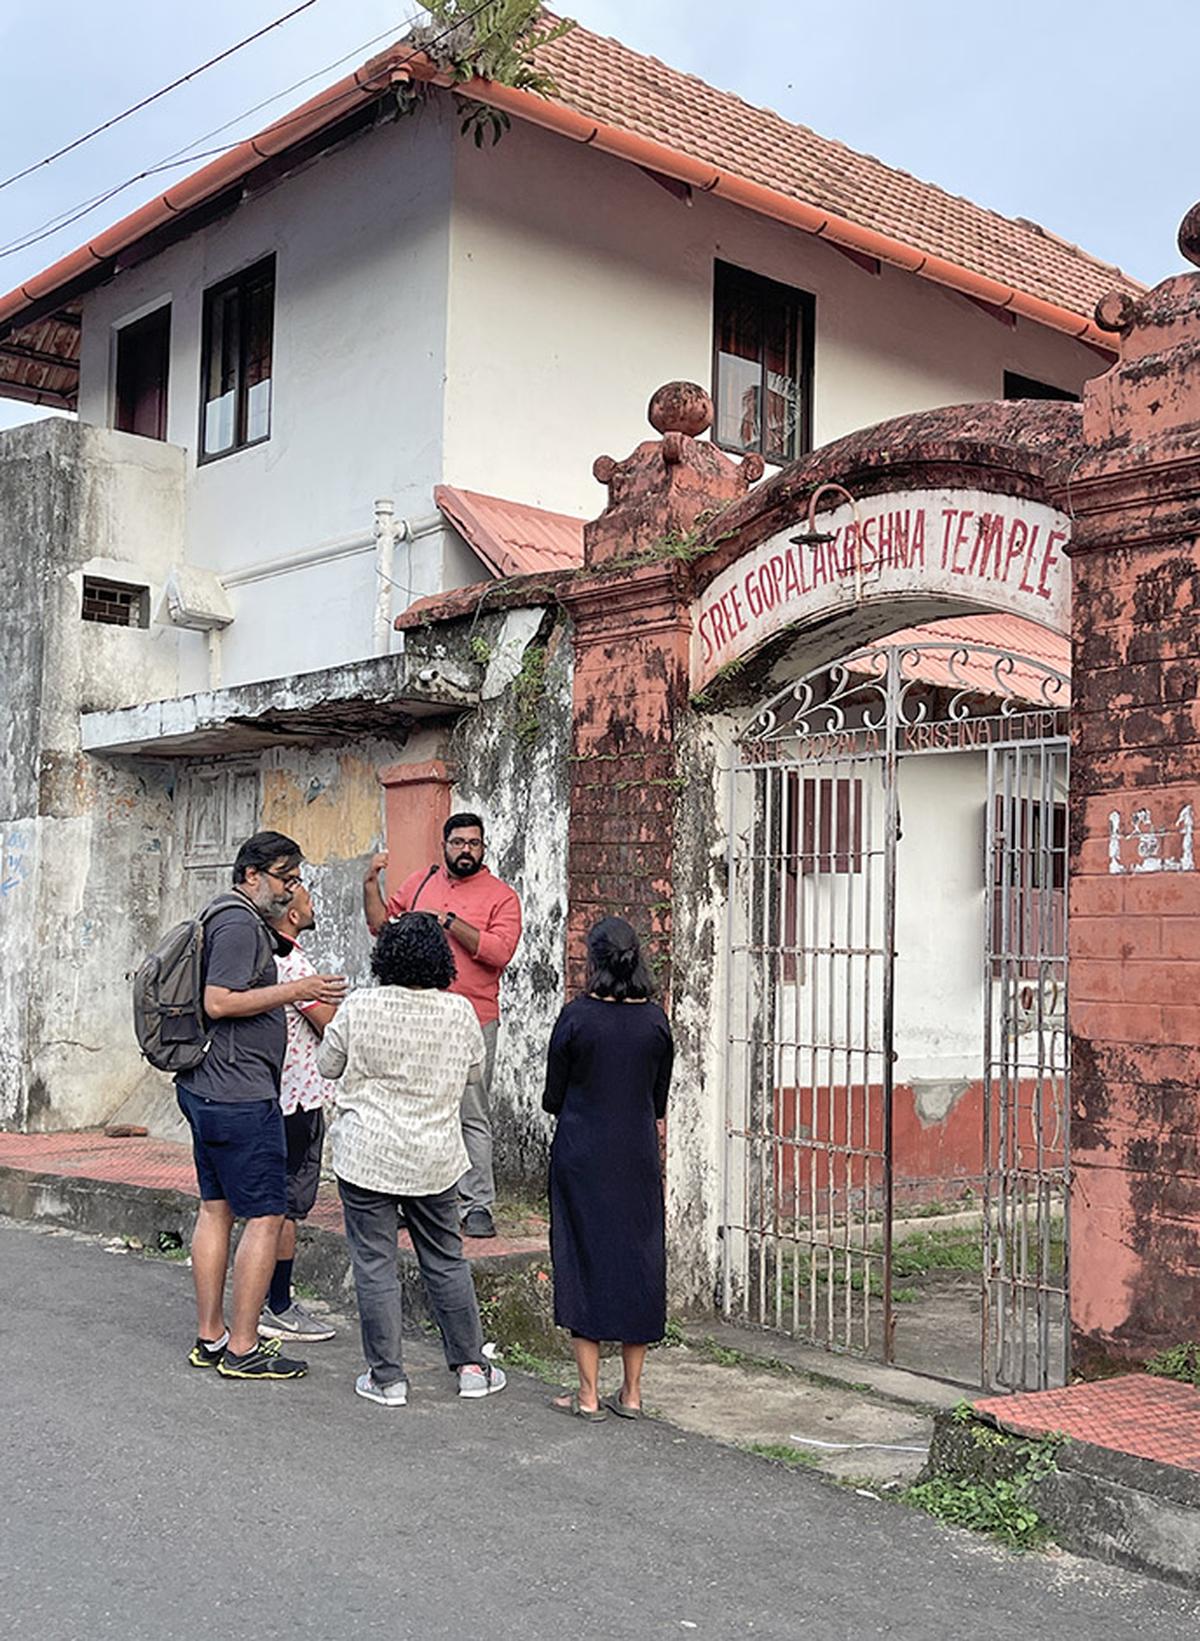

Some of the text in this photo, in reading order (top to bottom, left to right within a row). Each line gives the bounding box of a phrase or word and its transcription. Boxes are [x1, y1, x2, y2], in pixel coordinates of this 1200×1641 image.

[698, 509, 1067, 664] SREE GOPALAKRSHNA TEMPLE
[903, 717, 993, 752] KRISHNA
